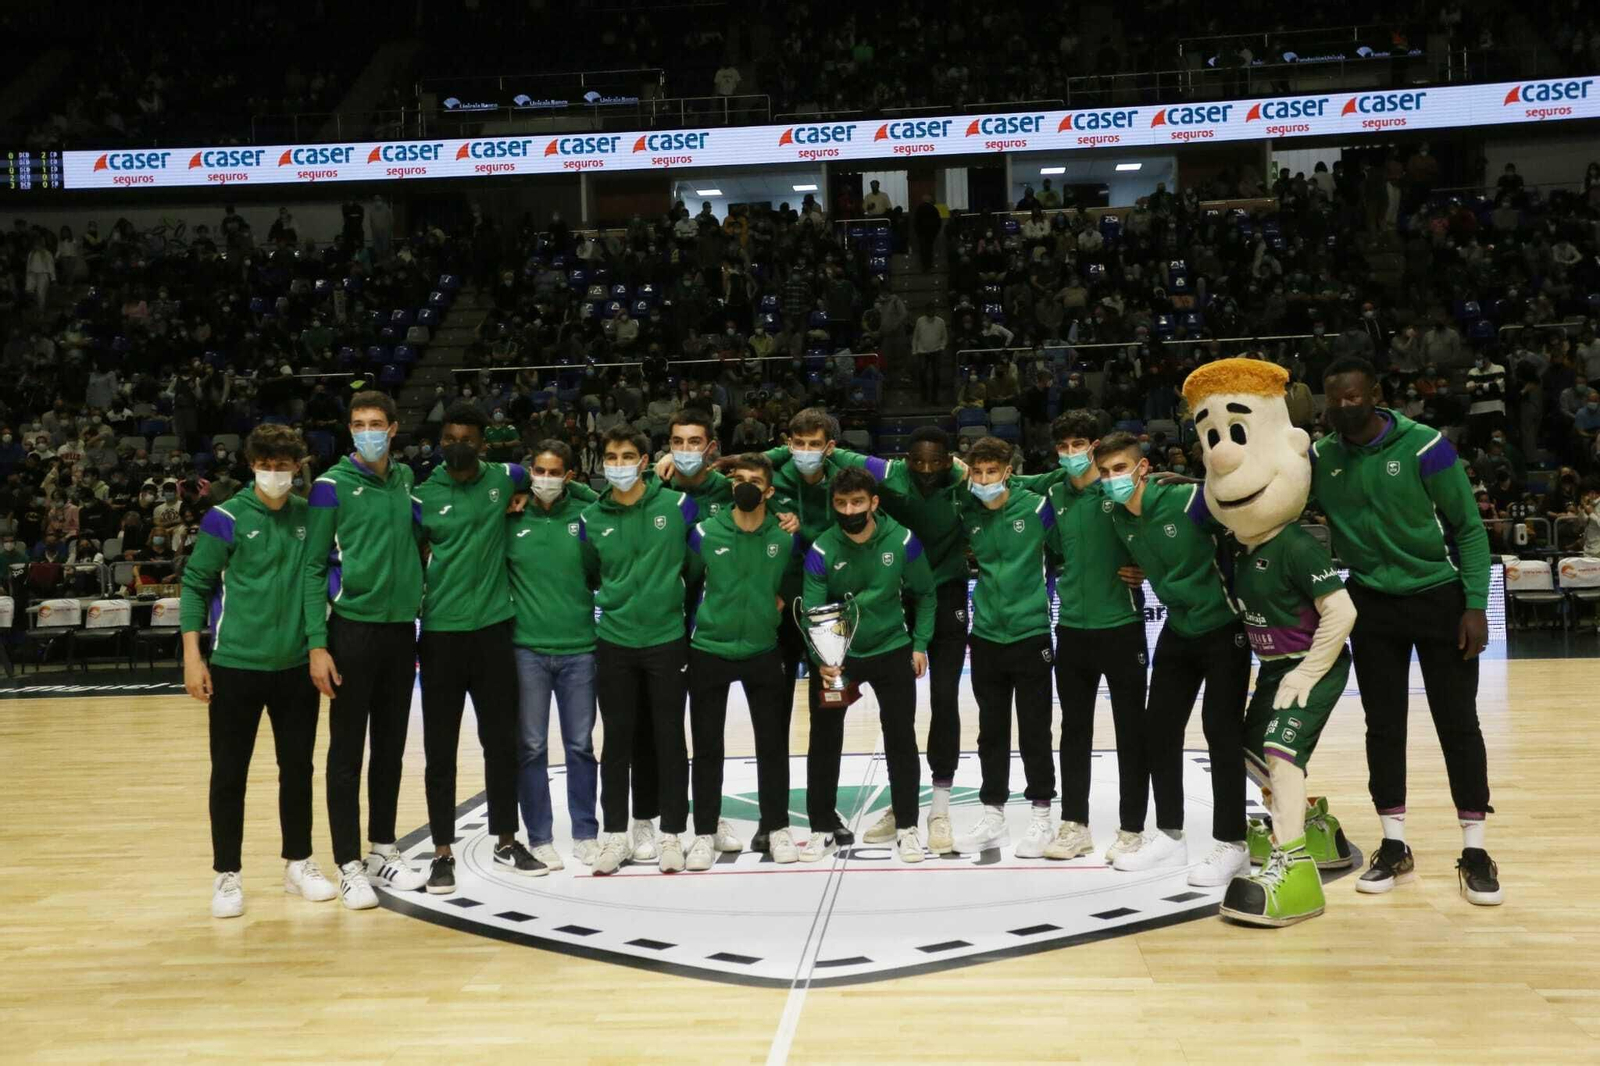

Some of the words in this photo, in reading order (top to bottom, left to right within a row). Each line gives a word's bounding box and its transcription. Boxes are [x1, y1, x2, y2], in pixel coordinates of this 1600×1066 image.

[1522, 80, 1593, 102] caser
[1262, 98, 1329, 120] caser
[1359, 92, 1426, 113] caser
[1074, 110, 1138, 130] caser
[1168, 105, 1233, 125] caser
[1526, 106, 1572, 119] seguros
[890, 120, 952, 139] caser
[981, 116, 1045, 135] caser
[1267, 124, 1308, 137] seguros
[1363, 117, 1406, 130] seguros
[648, 132, 709, 151] caser
[794, 125, 856, 144] caser
[1078, 135, 1118, 147] seguros
[1172, 130, 1213, 142] seguros
[383, 144, 443, 162] caser
[471, 140, 532, 158] caser
[560, 136, 621, 155] caser
[894, 144, 934, 157] seguros
[986, 140, 1026, 152] seguros
[109, 152, 171, 170] caser
[204, 150, 265, 168] caser
[293, 147, 354, 165] caser
[654, 156, 692, 168] seguros
[799, 149, 838, 162] seguros
[388, 167, 426, 179] seguros
[475, 164, 514, 176] seguros
[565, 159, 604, 172] seguros
[113, 175, 154, 187] seguros
[208, 173, 248, 185] seguros
[298, 170, 338, 182] seguros
